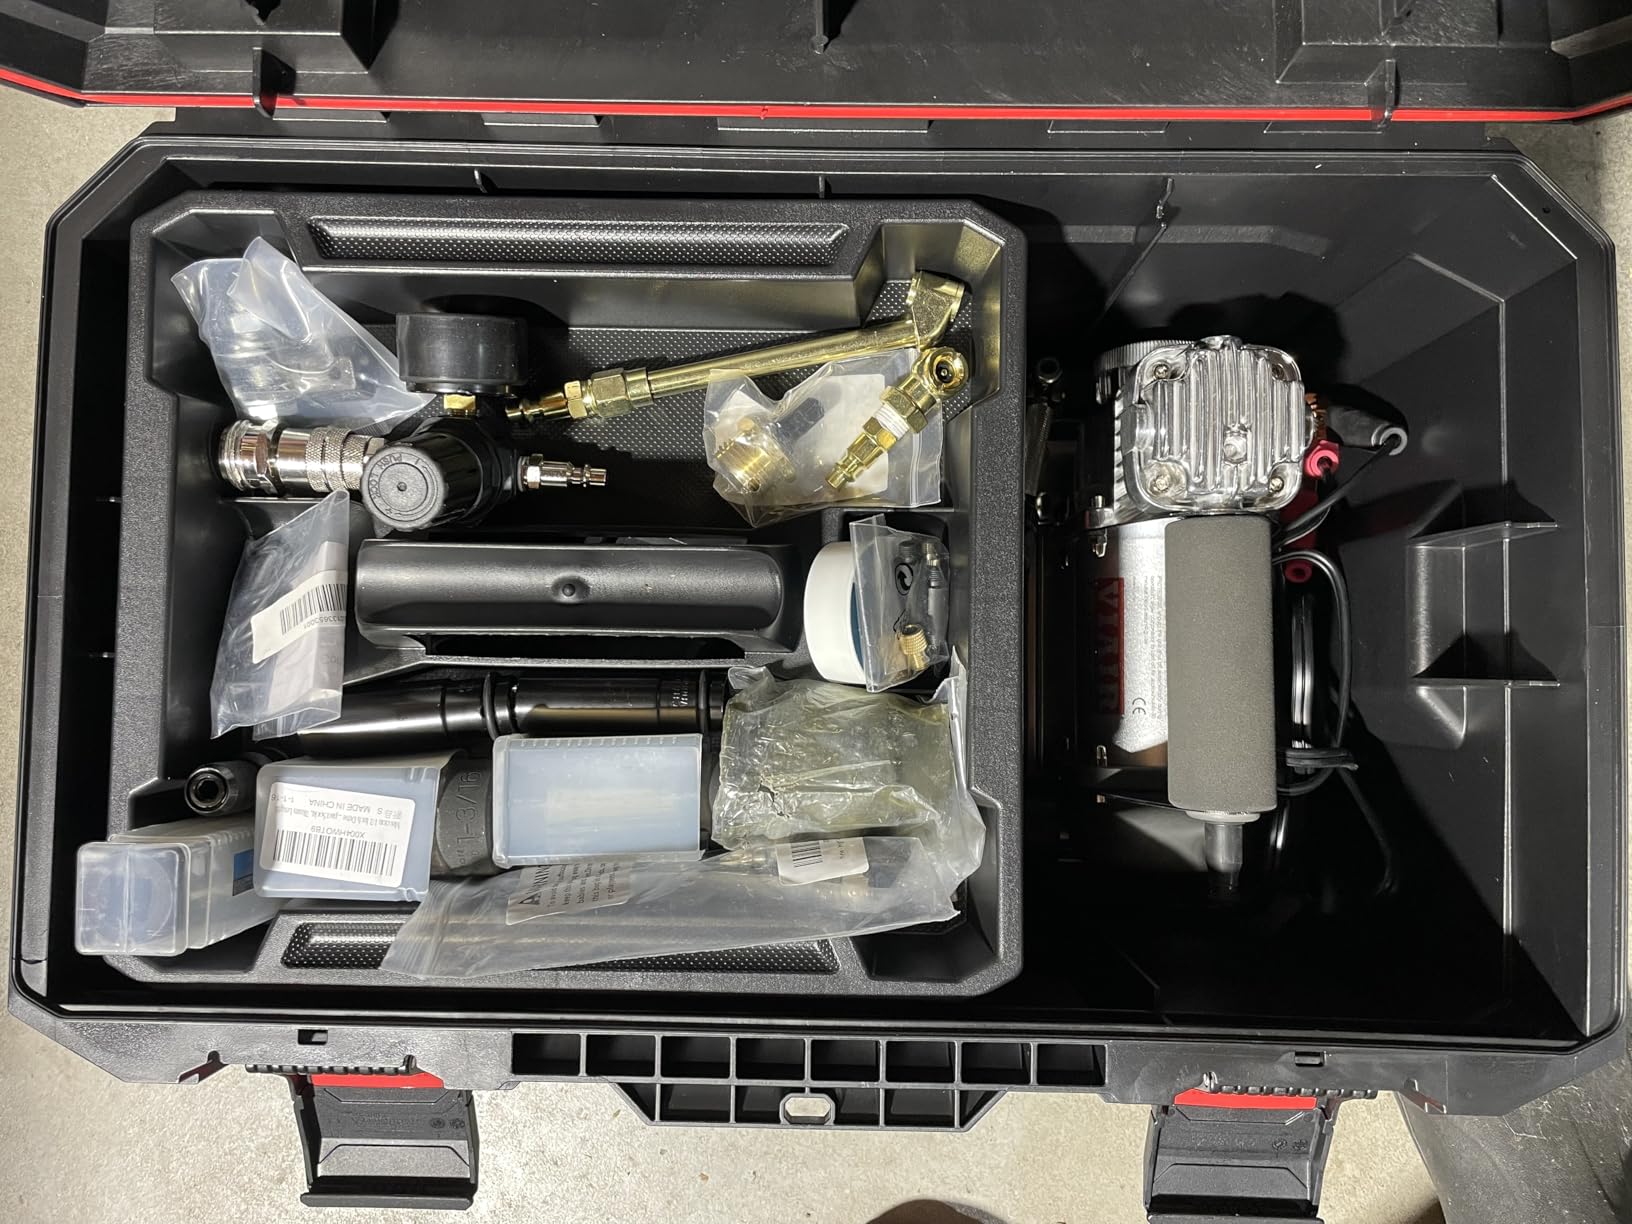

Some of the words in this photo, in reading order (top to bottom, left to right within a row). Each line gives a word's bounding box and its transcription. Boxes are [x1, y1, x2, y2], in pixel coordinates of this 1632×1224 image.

[309, 799, 335, 809] CHINA
[336, 803, 345, 811] IN
[347, 805, 370, 814] MADE
